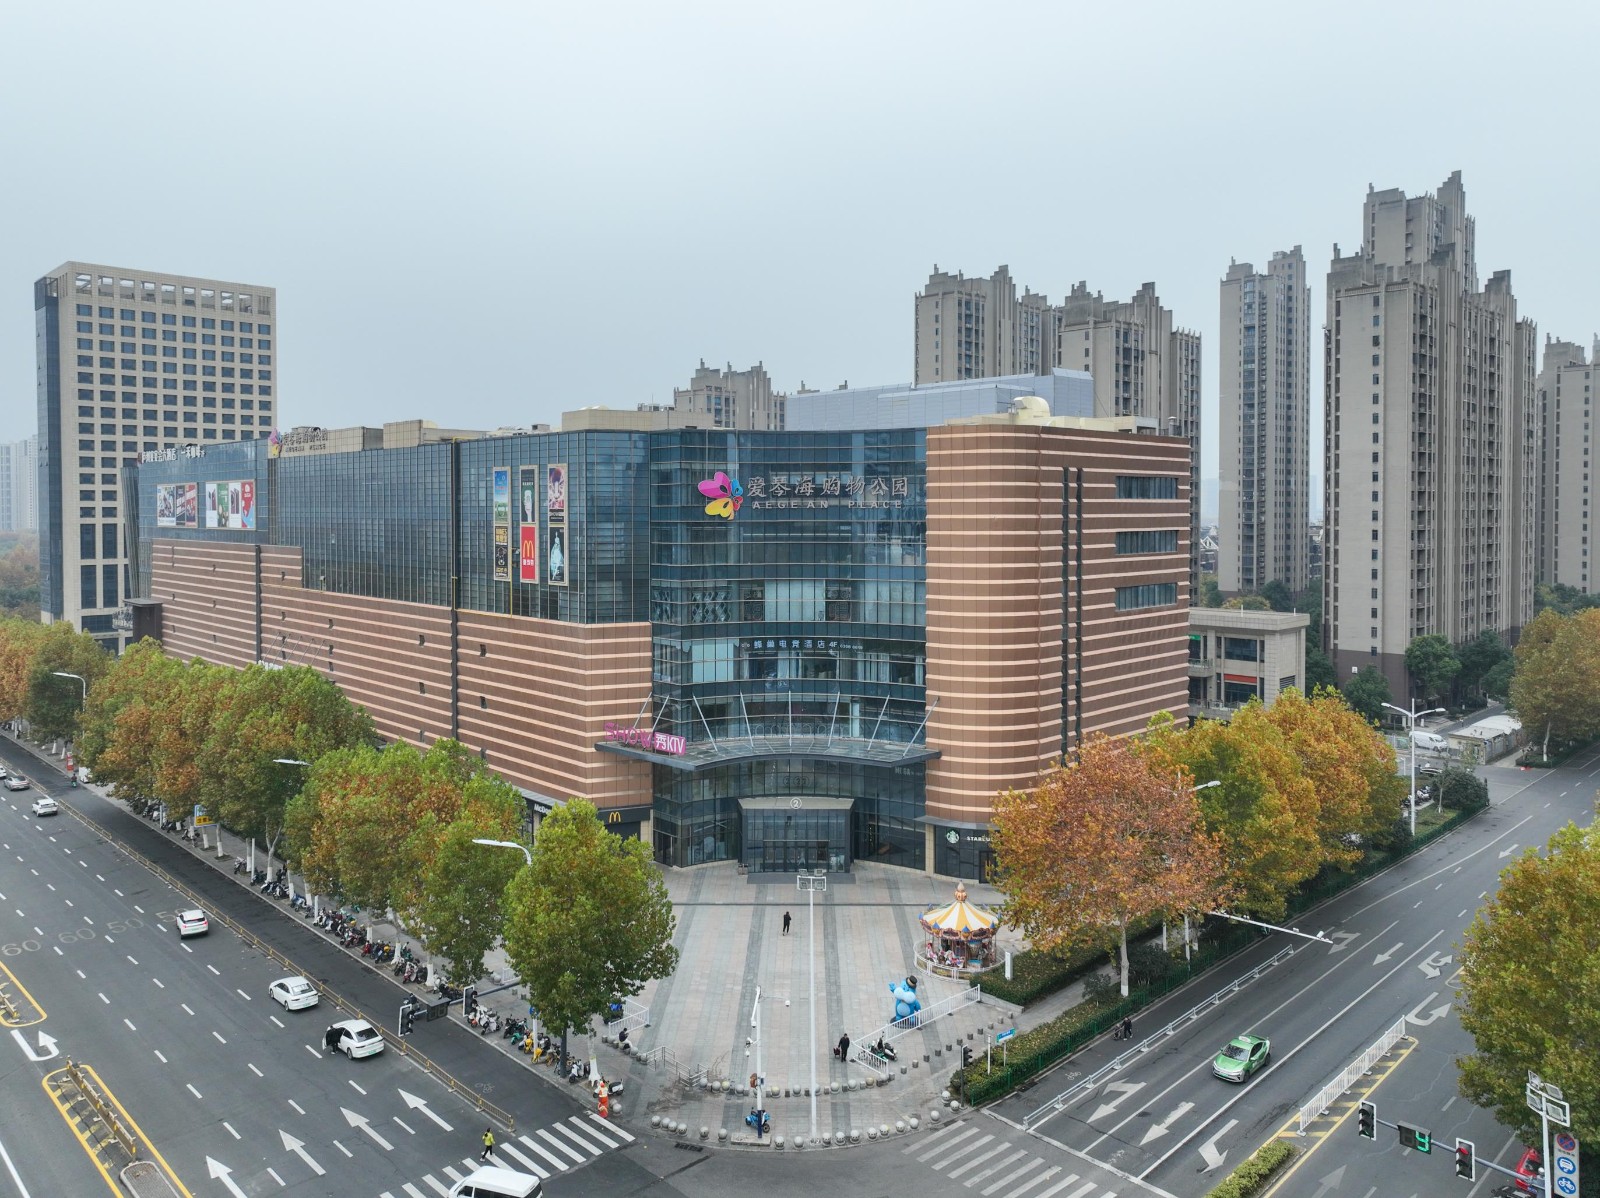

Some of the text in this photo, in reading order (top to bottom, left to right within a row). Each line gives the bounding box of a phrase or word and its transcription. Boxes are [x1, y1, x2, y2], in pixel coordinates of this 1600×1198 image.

[747, 475, 908, 497] 爱琴海购物公园
[752, 501, 902, 509] AEGEAN PLACE
[655, 733, 685, 754] 秀KTV
[106, 918, 144, 934] 50
[58, 928, 96, 944] 60
[1, 939, 42, 956] 60
